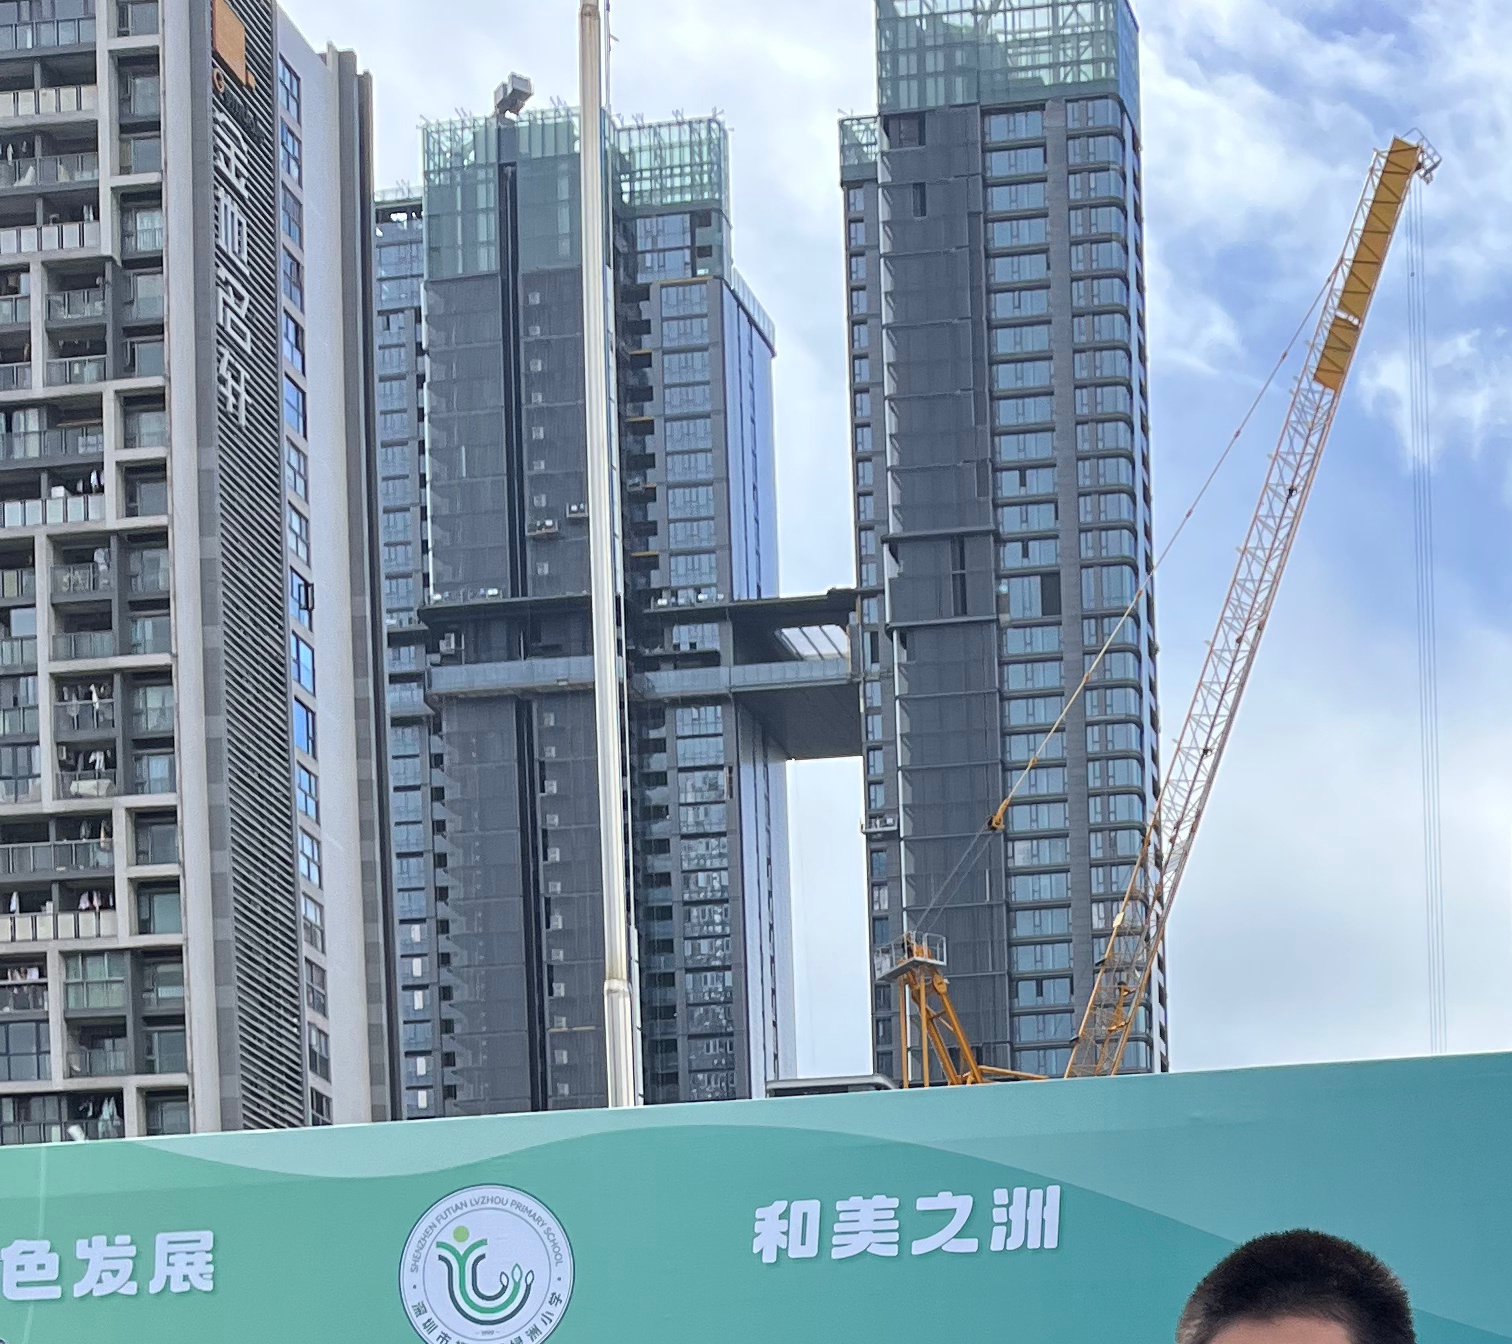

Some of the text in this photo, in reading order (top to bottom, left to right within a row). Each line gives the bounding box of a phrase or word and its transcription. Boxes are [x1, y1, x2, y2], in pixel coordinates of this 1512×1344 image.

[410, 1195, 565, 1273] SHENZHEN FUTIAN LVZHOU PRIMARY SCHOOL
[752, 1185, 1061, 1264] 和美之洲
[0, 1230, 215, 1300] 色发展
